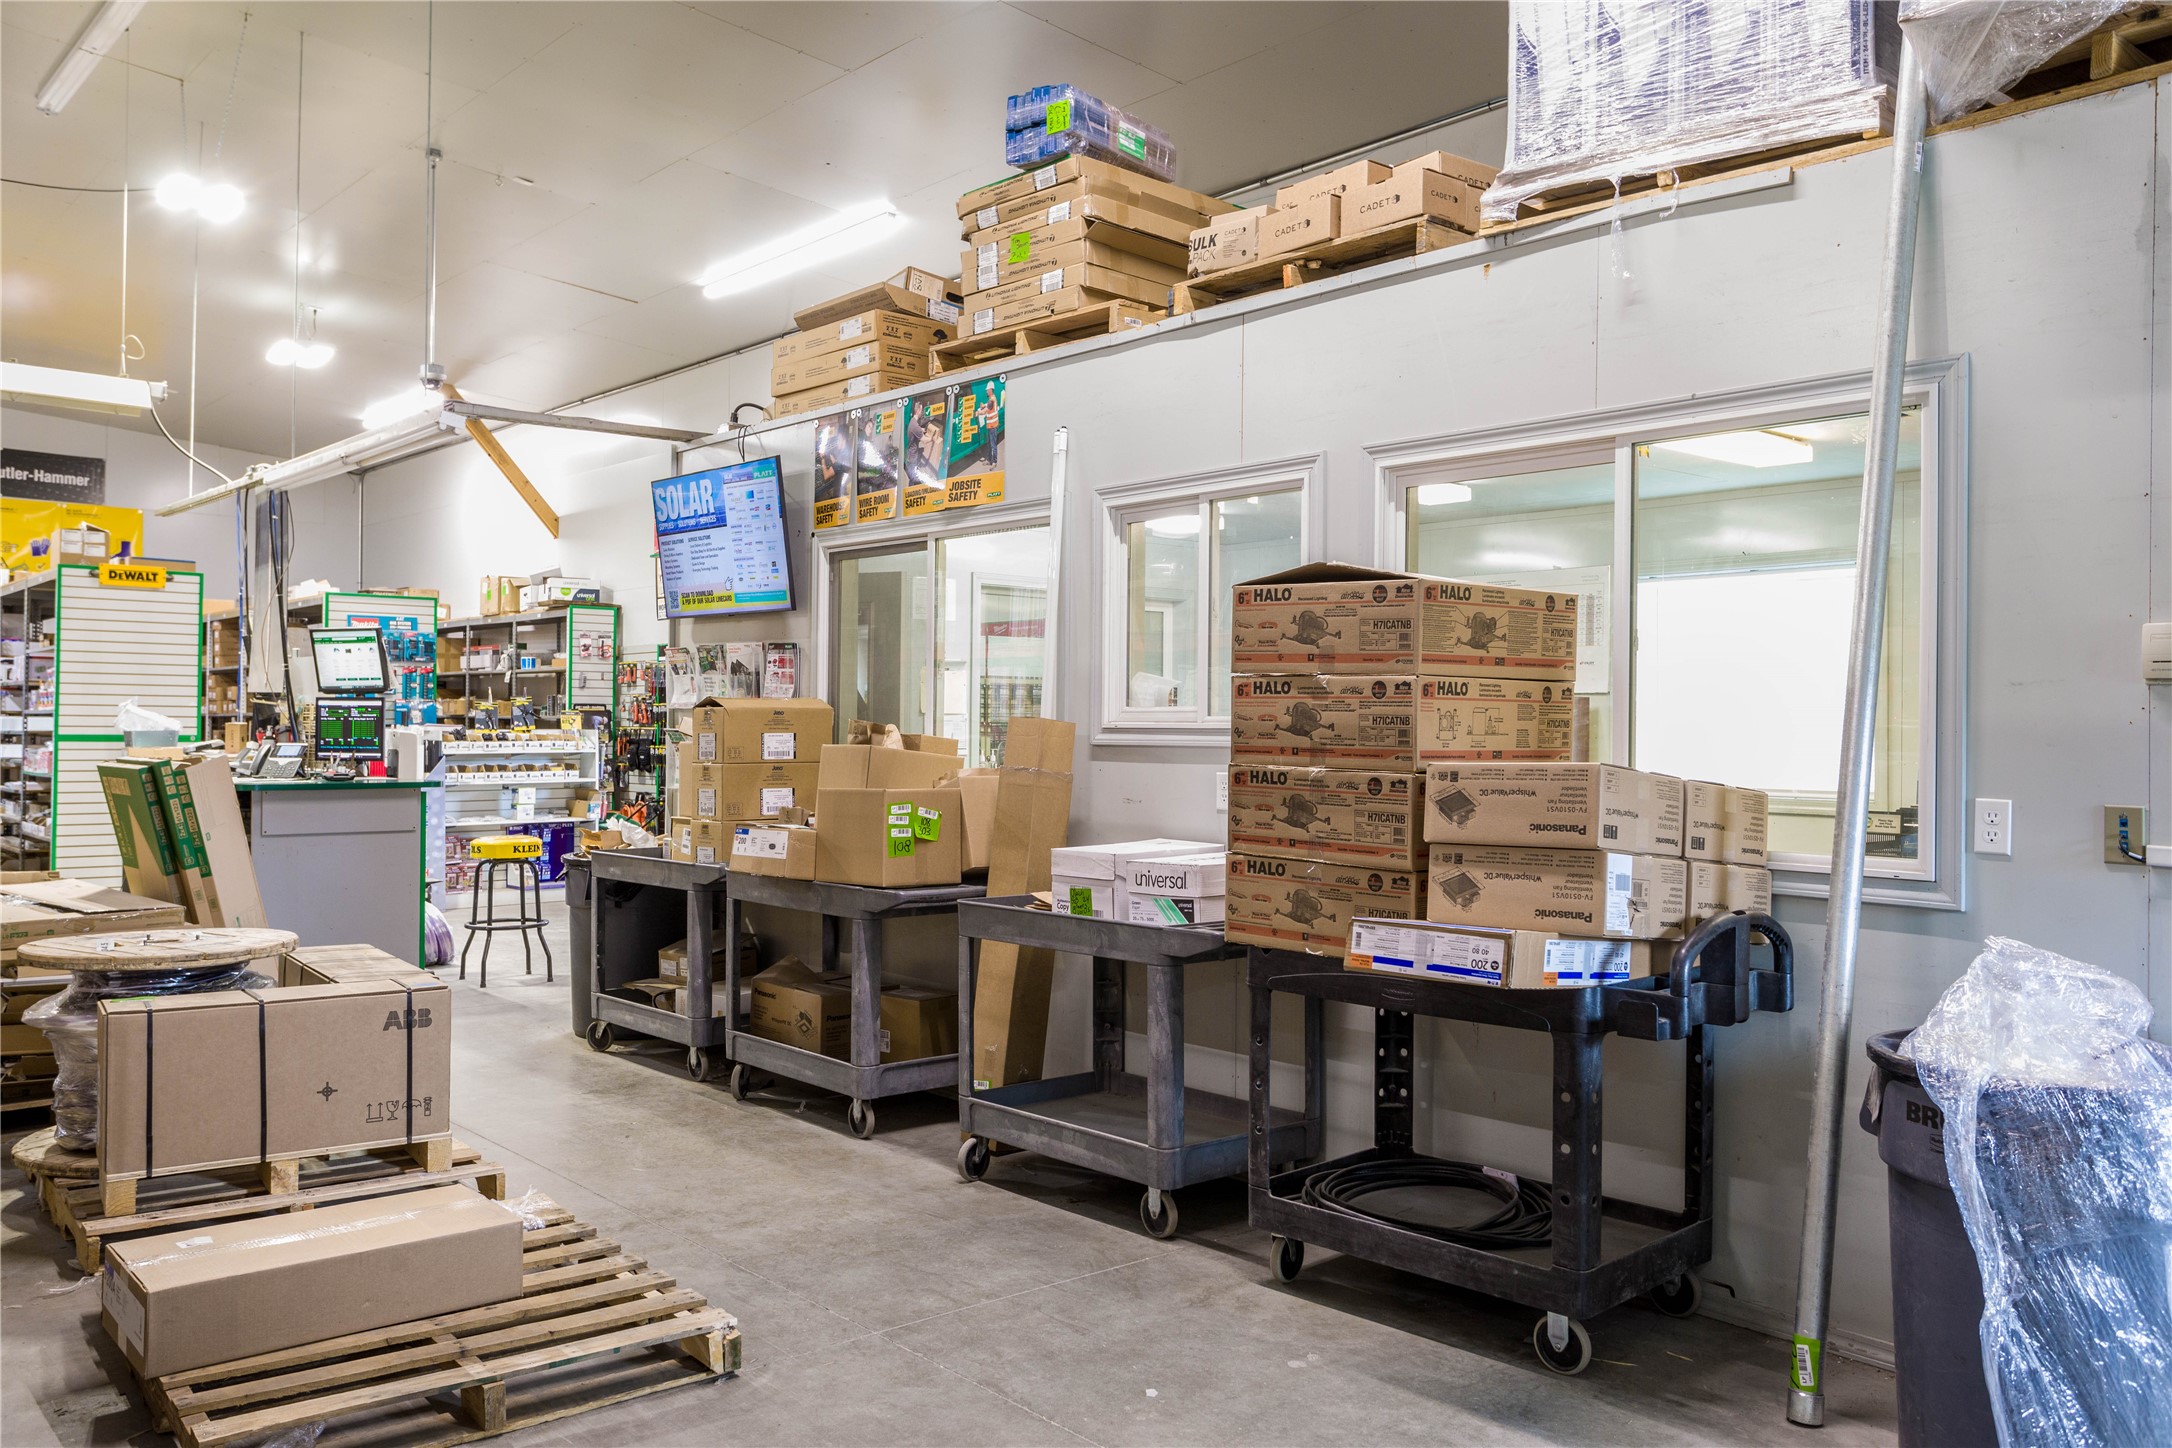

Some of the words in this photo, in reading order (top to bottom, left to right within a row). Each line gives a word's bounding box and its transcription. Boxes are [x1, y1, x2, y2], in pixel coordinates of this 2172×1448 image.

[1457, 174, 1486, 187] CADET
[1431, 189, 1452, 201] CADET
[1360, 198, 1391, 214] CADET
[1224, 228, 1241, 236] CADET
[1275, 222, 1301, 237] CADET
[1192, 249, 1216, 262] PACK
[753, 470, 773, 478] PLATT
[949, 478, 981, 492] JOBSITE
[655, 478, 715, 522] SOLAR
[859, 497, 873, 509] WIRE
[874, 493, 890, 506] ROOM
[905, 496, 927, 509] SAFETY
[948, 490, 978, 503] SAFETY
[859, 506, 879, 519] SAFETY
[816, 513, 834, 526] SAFETY
[1253, 588, 1292, 602] HALO
[1440, 585, 1472, 601] HALO
[1372, 620, 1412, 630] H7ICATNB
[1253, 681, 1291, 695] HALO
[1437, 681, 1469, 697] HALO
[1372, 715, 1411, 726] H7ICATNB
[1250, 770, 1288, 786] HALO
[1479, 788, 1489, 797] DC
[1491, 787, 1537, 798] WhisperValue
[1367, 812, 1406, 825] H7ICATNB
[1530, 823, 1587, 836] Panasonic
[513, 844, 541, 853] KLEIN
[894, 839, 912, 856] 108
[1655, 837, 1679, 847] Panasonic
[1741, 847, 1764, 857] Panasonic
[1247, 860, 1286, 877] HALO
[1135, 870, 1187, 890] universal
[1484, 872, 1494, 880] DC
[1495, 872, 1542, 883] WhisperValue
[1057, 902, 1069, 911] Copy
[1534, 908, 1592, 923] Panasonic
[1660, 921, 1682, 930] Panasonic
[1471, 958, 1488, 971] 200
[1614, 962, 1623, 972] 200
[754, 987, 777, 1000] Panasonic
[382, 1008, 433, 1032] ABB
